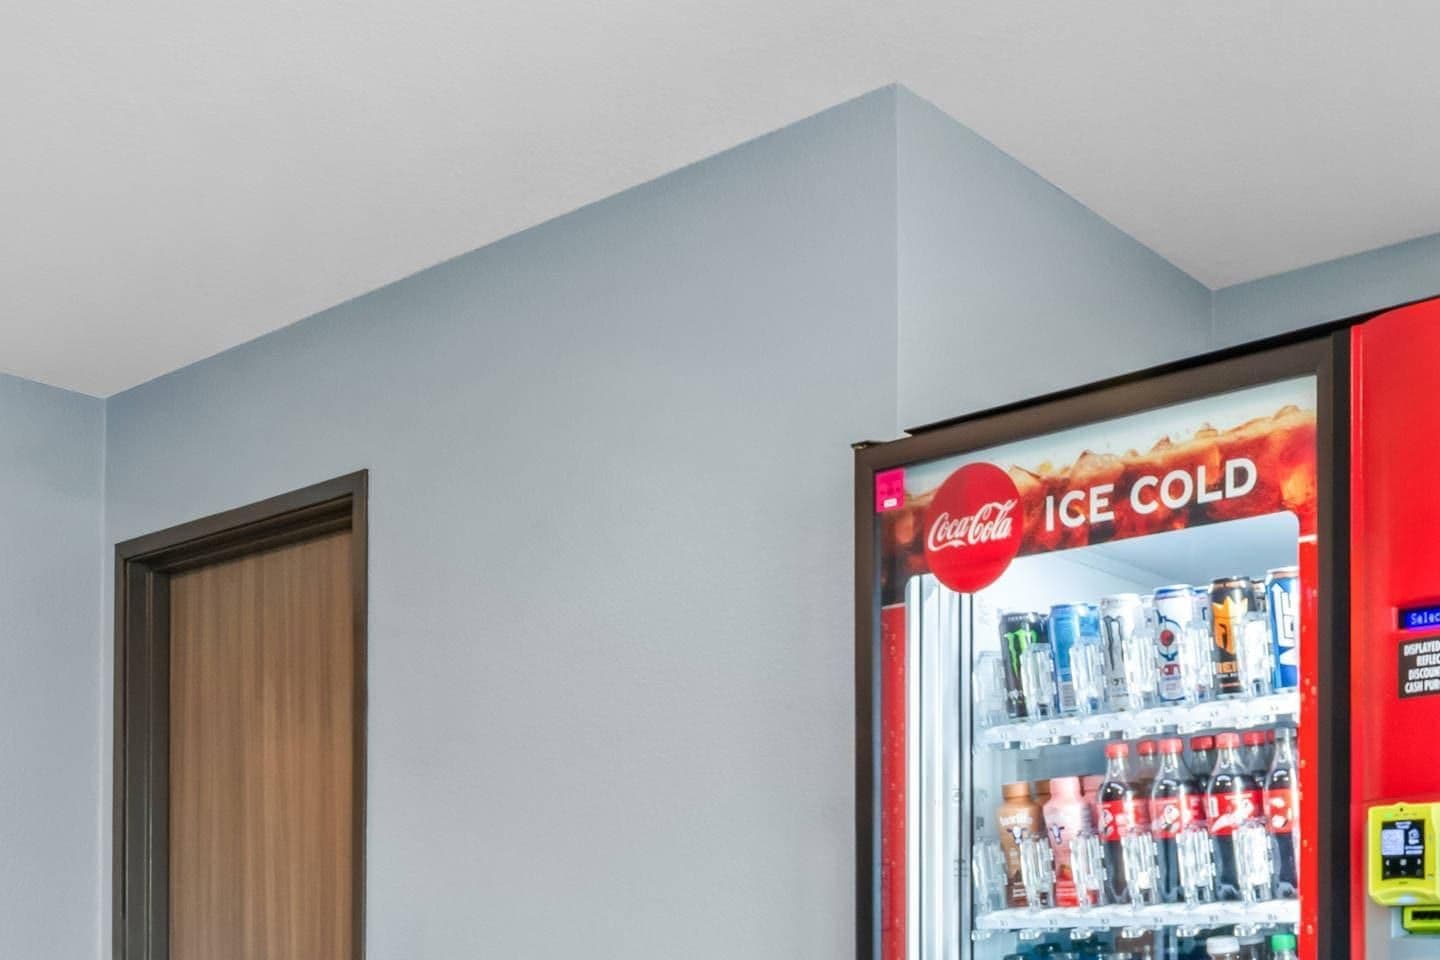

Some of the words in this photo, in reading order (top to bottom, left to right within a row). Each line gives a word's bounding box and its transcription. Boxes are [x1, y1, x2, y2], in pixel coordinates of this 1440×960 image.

[1045, 485, 1115, 532] ICE
[1129, 457, 1258, 515] COLD
[927, 500, 1019, 554] Coca-Cola
[1403, 640, 1440, 656] DISPLAYED
[1404, 680, 1424, 694] CASH
